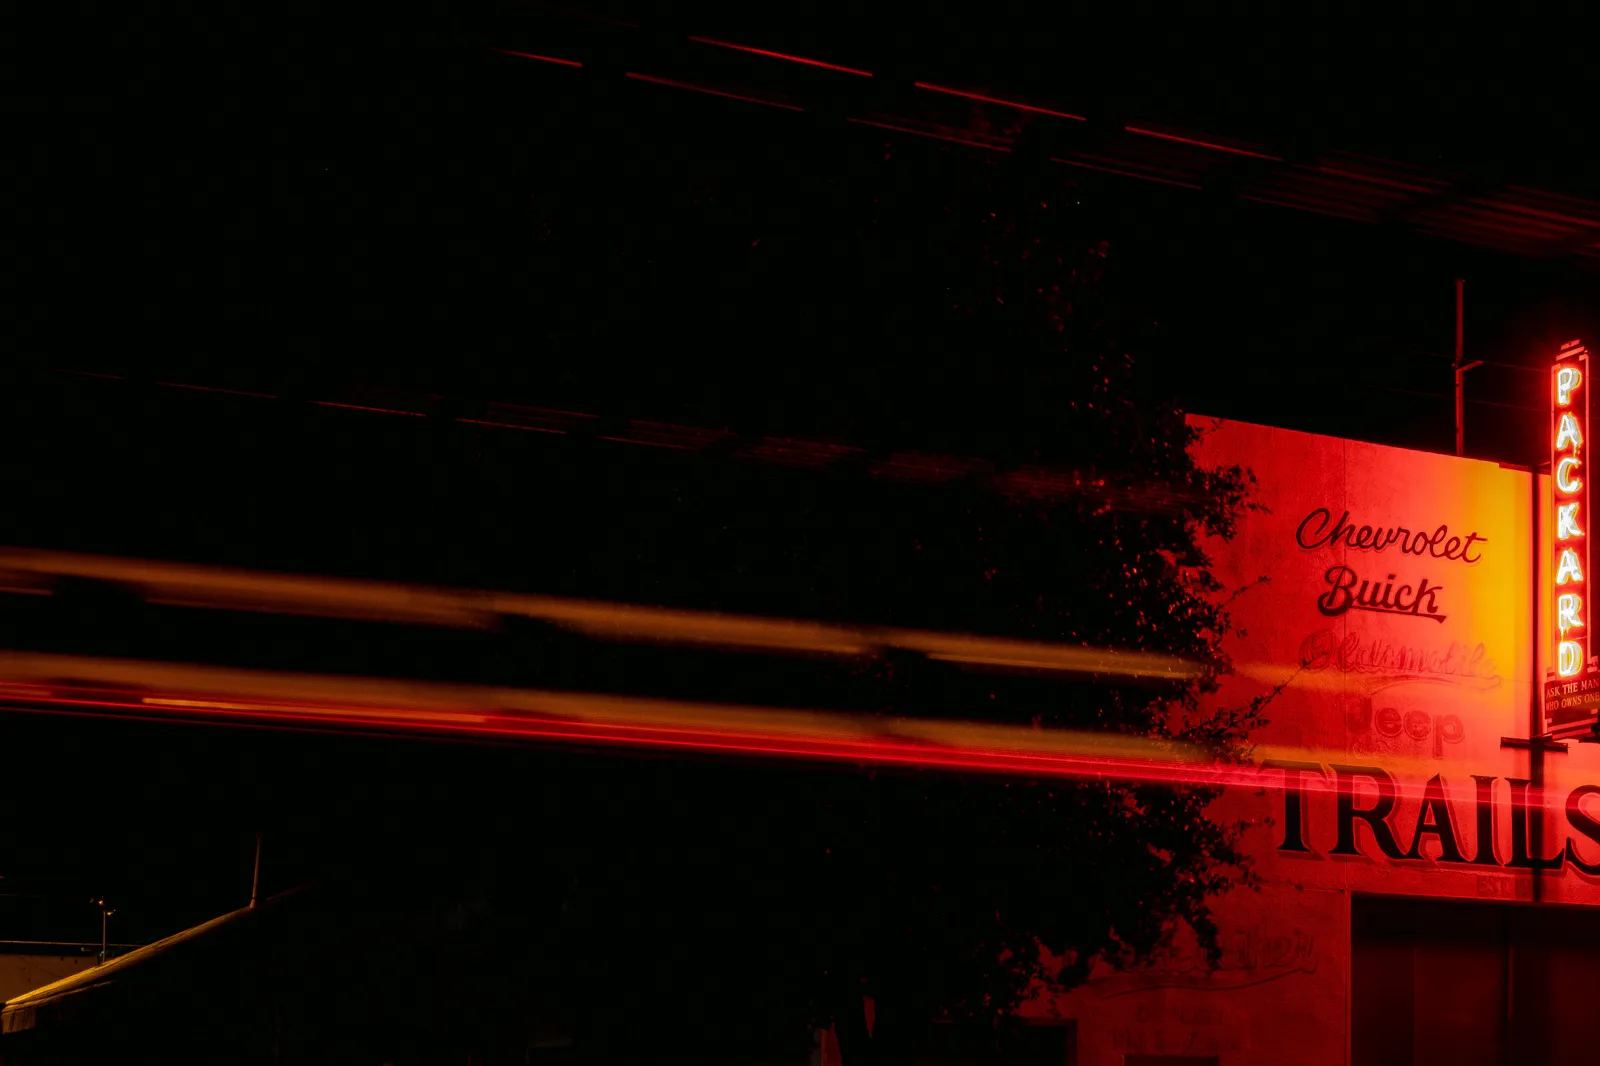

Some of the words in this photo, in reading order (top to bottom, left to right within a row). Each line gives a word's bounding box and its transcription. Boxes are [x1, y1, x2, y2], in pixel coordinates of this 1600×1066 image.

[1295, 507, 1488, 563] Chevrolet
[1555, 367, 1585, 677] PACKARD
[1317, 565, 1446, 621] Buick
[1545, 686, 1560, 699] ASK
[1562, 682, 1578, 695] THE
[1581, 678, 1600, 691] MAN
[1545, 701, 1560, 712] WHO
[1561, 695, 1582, 708] OWNS
[1584, 691, 1600, 703] ONE
[1347, 698, 1466, 760] Jeep
